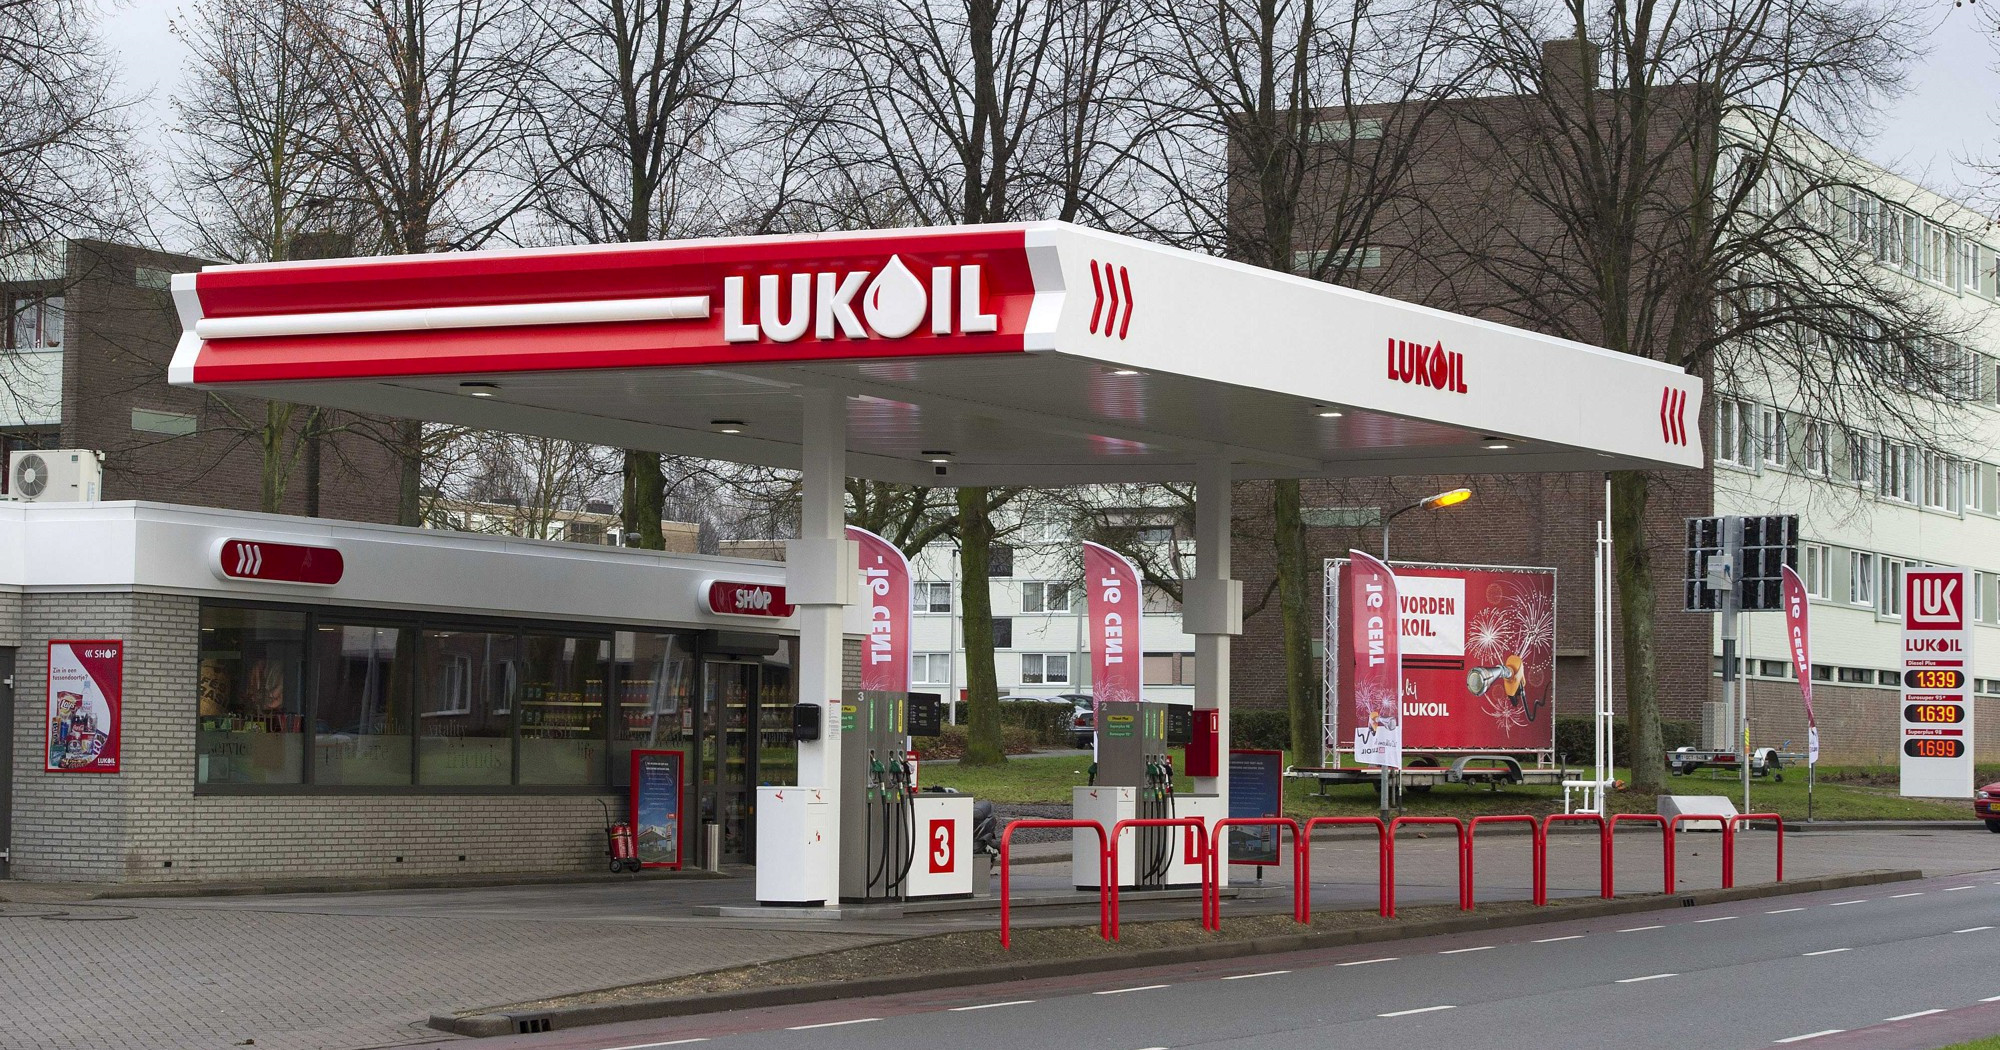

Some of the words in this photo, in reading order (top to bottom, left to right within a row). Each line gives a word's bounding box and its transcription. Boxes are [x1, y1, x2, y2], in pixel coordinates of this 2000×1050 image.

[724, 254, 998, 343] LUKOIL
[1387, 337, 1468, 395] LUKOIL
[735, 586, 772, 610] SHOP
[1905, 637, 1963, 653] LUKOIL
[94, 648, 117, 659] SHOP
[52, 674, 89, 682] tussendoortje?
[857, 691, 865, 701] 3
[1405, 678, 1418, 701] bij
[1101, 703, 1107, 711] 2
[1135, 703, 1140, 711] 1
[1403, 702, 1450, 717] LUKOIL
[1212, 715, 1217, 730] 1
[933, 825, 951, 867] 3
[1190, 824, 1198, 858] 1
